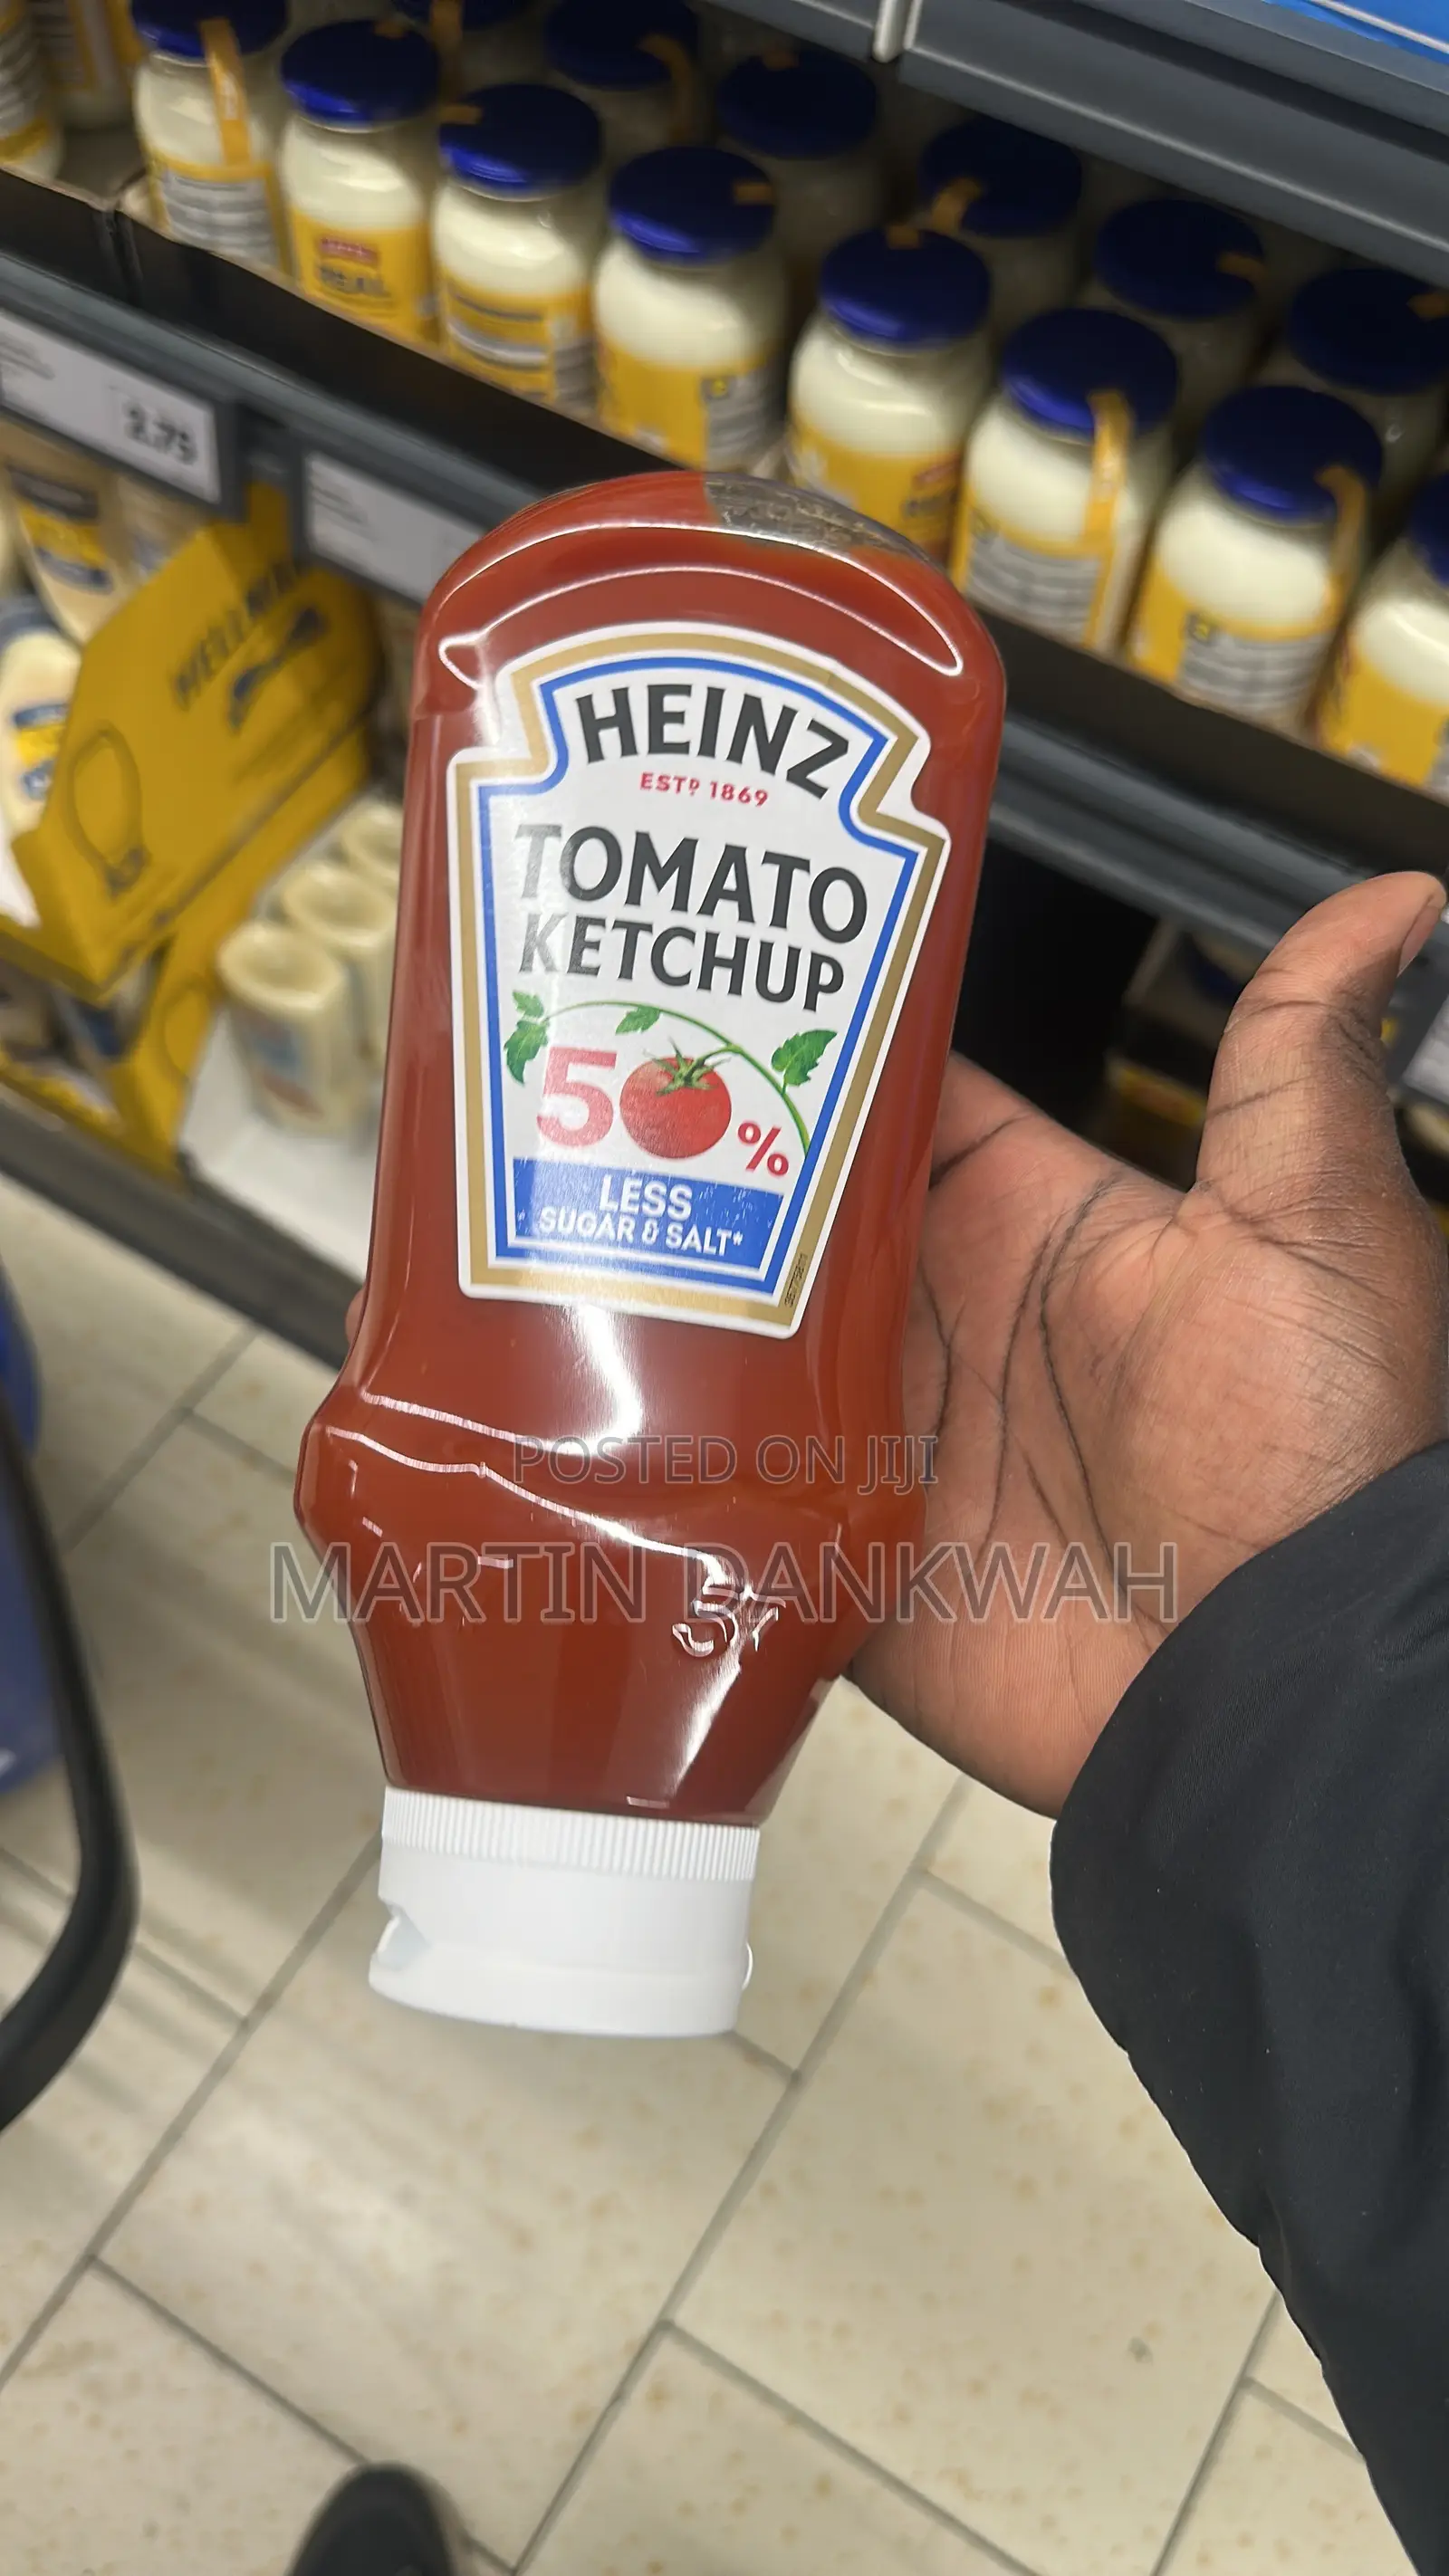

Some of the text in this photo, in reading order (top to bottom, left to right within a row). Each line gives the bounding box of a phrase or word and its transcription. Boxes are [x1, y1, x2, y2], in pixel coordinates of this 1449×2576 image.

[575, 683, 849, 800] HEINZ
[709, 780, 769, 808] 1869
[513, 823, 868, 943] TOMATO
[517, 912, 844, 1012] KETCHUP
[539, 1205, 636, 1243] SUGAR
[641, 1218, 658, 1246] &
[599, 1173, 693, 1221] LESS
